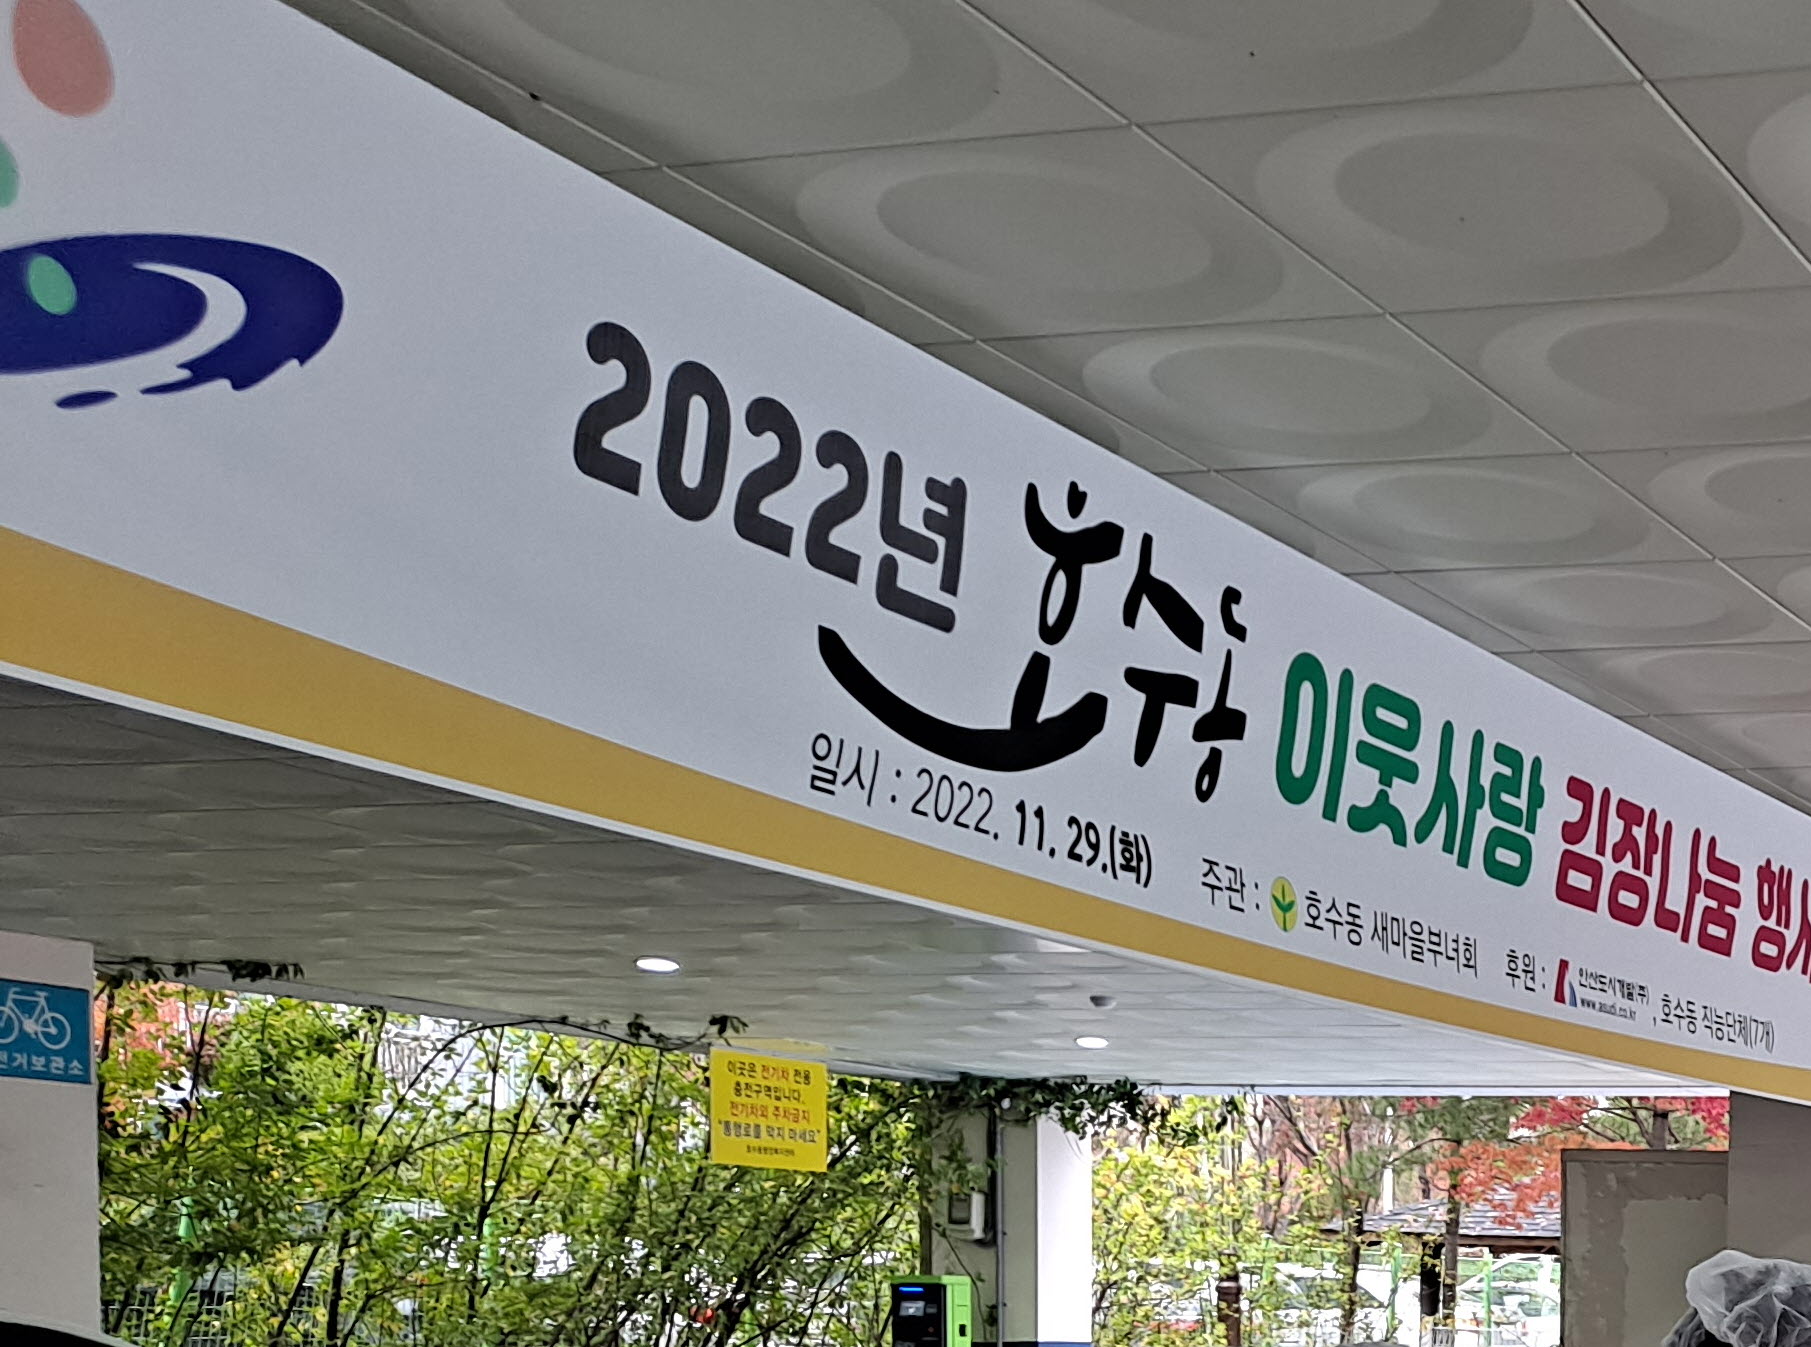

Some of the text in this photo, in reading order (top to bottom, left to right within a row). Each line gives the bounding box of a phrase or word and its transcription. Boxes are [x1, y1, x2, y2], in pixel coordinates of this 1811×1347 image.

[573, 321, 967, 633] 2022년
[1275, 652, 1545, 887] 이웃사랑
[1555, 775, 1742, 958] 김장나눔
[911, 768, 999, 840] 2022.
[1016, 799, 1056, 859] 11.
[1304, 890, 1364, 946] 호수동
[1371, 910, 1478, 978] 새마을부녀회
[1661, 994, 1697, 1034] 호수동
[728, 1060, 811, 1085] 이곳은 전기차 전용
[772, 1106, 810, 1123] 주차금지
